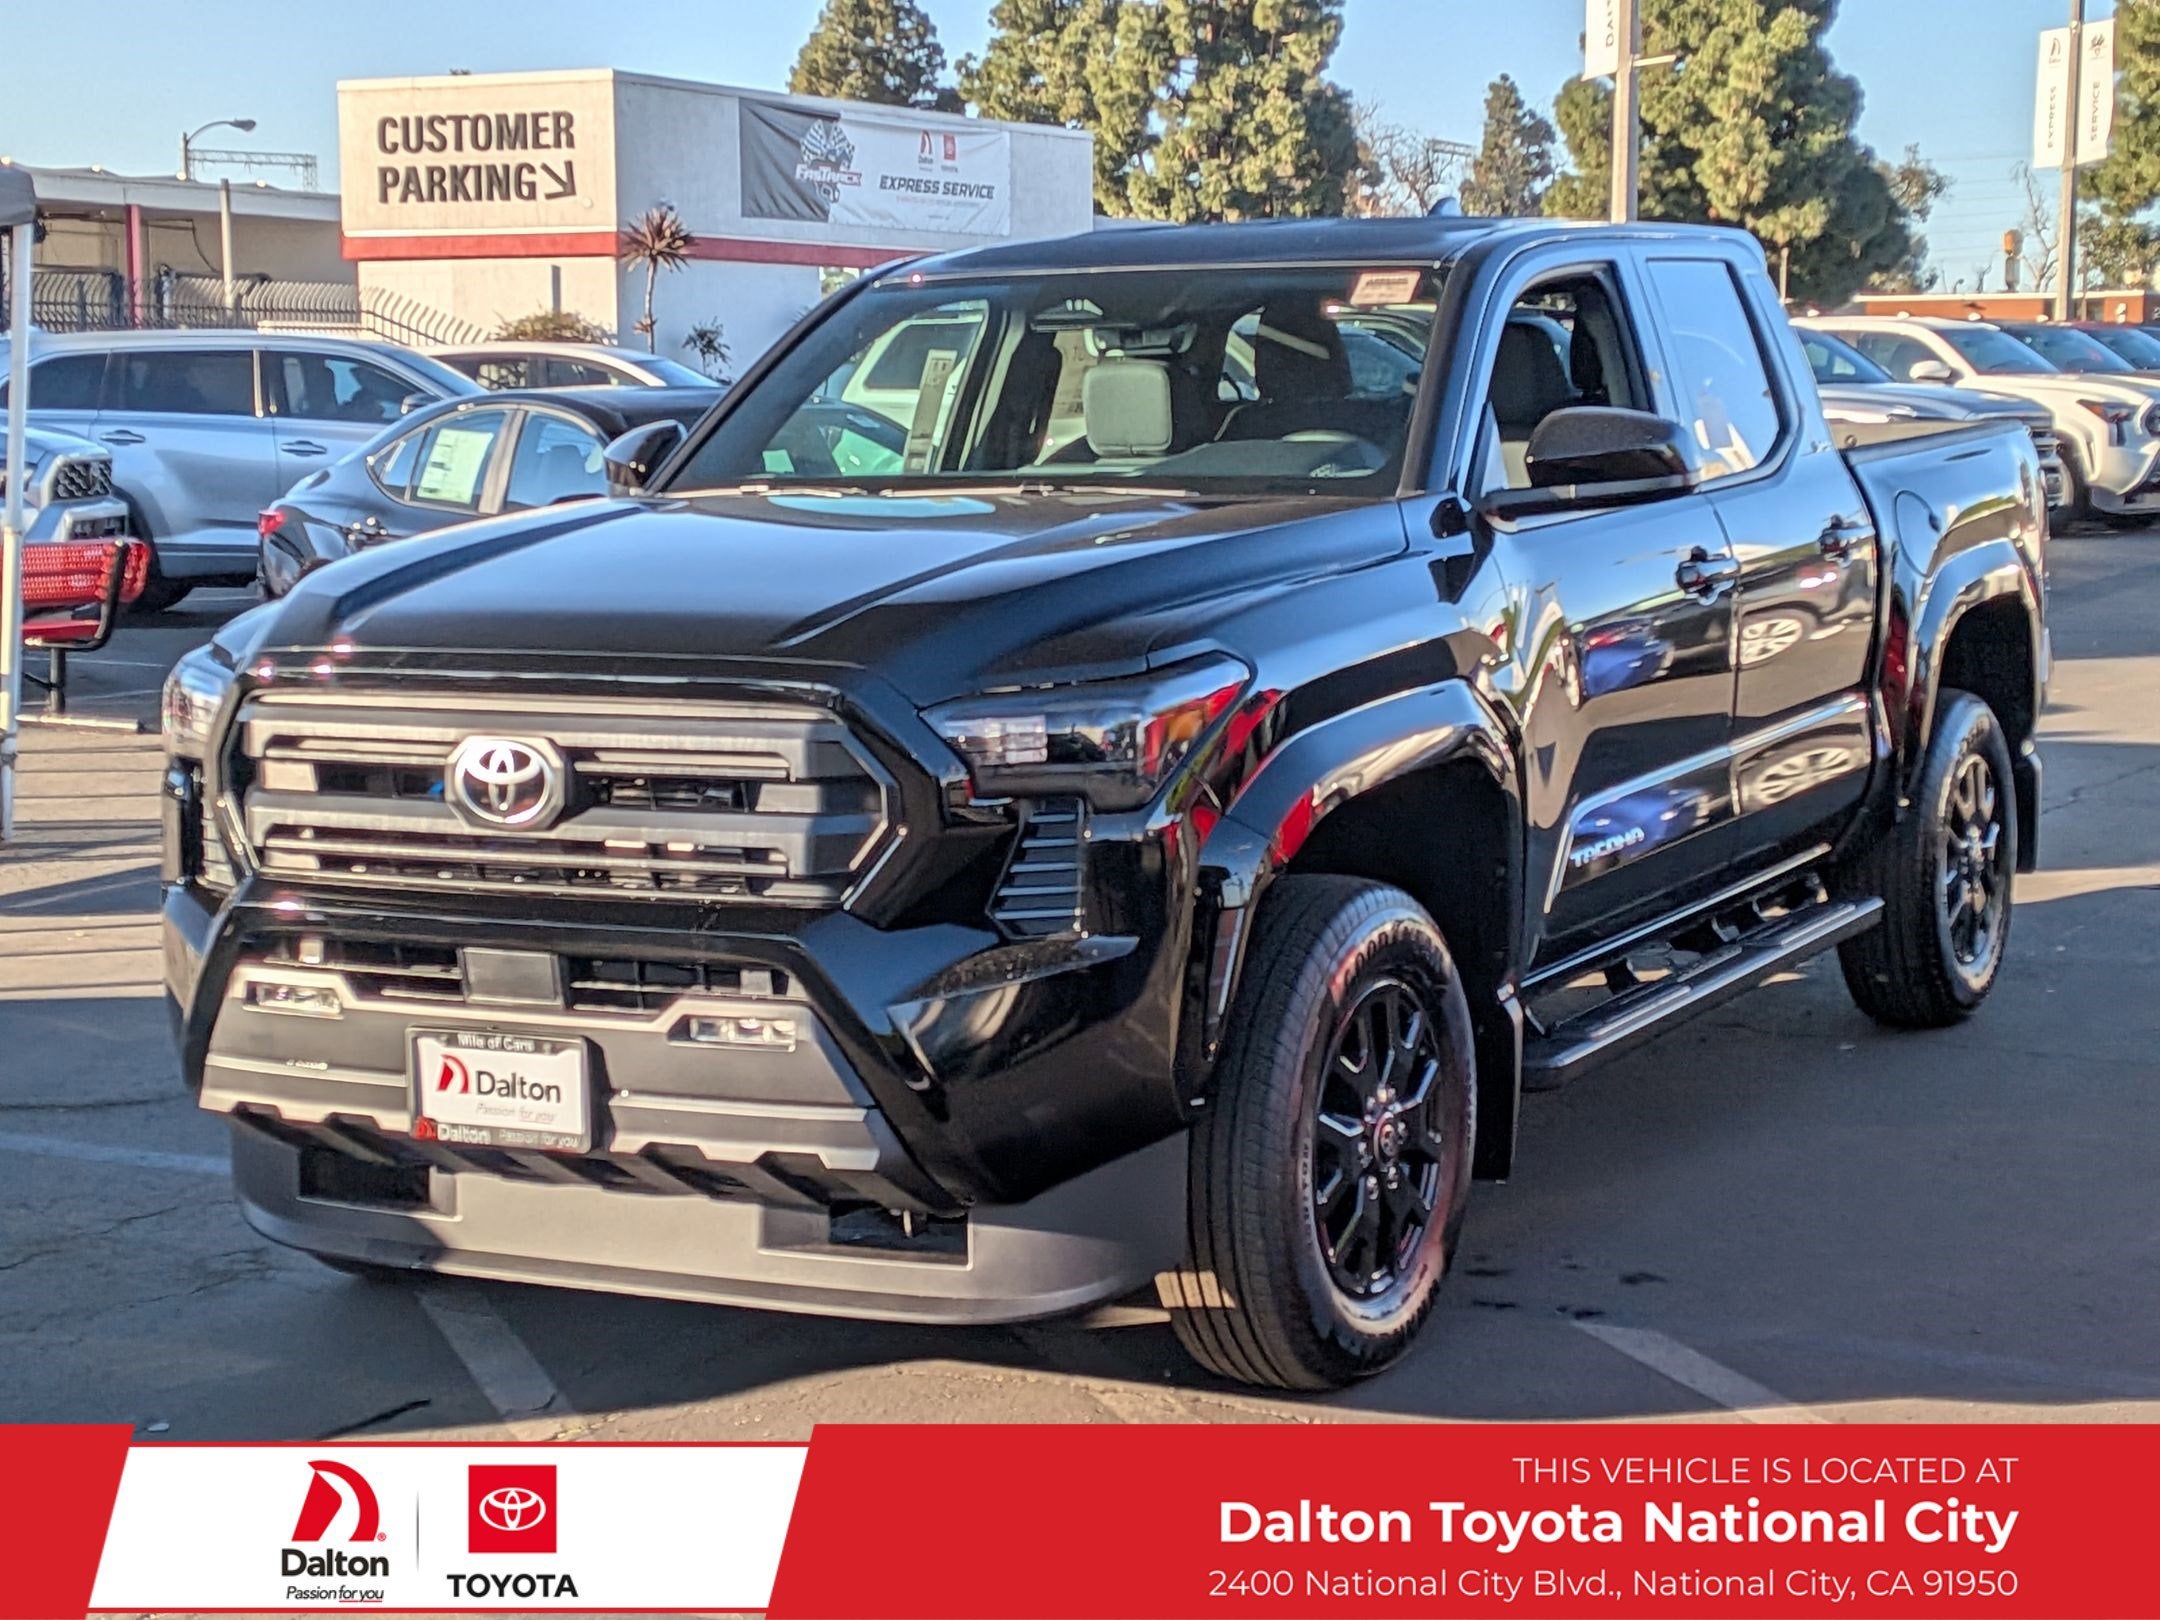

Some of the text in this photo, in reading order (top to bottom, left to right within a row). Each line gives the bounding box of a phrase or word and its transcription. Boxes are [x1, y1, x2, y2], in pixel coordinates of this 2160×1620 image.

[377, 111, 576, 154] CUSTOMER
[377, 162, 537, 204] PARKING
[879, 174, 995, 200] EXPRESS SERVICE
[1570, 827, 1645, 868] TACOMA
[457, 1033, 535, 1053] Mile of Cars
[476, 1070, 561, 1104] Dalton
[438, 1124, 492, 1145] Dalton
